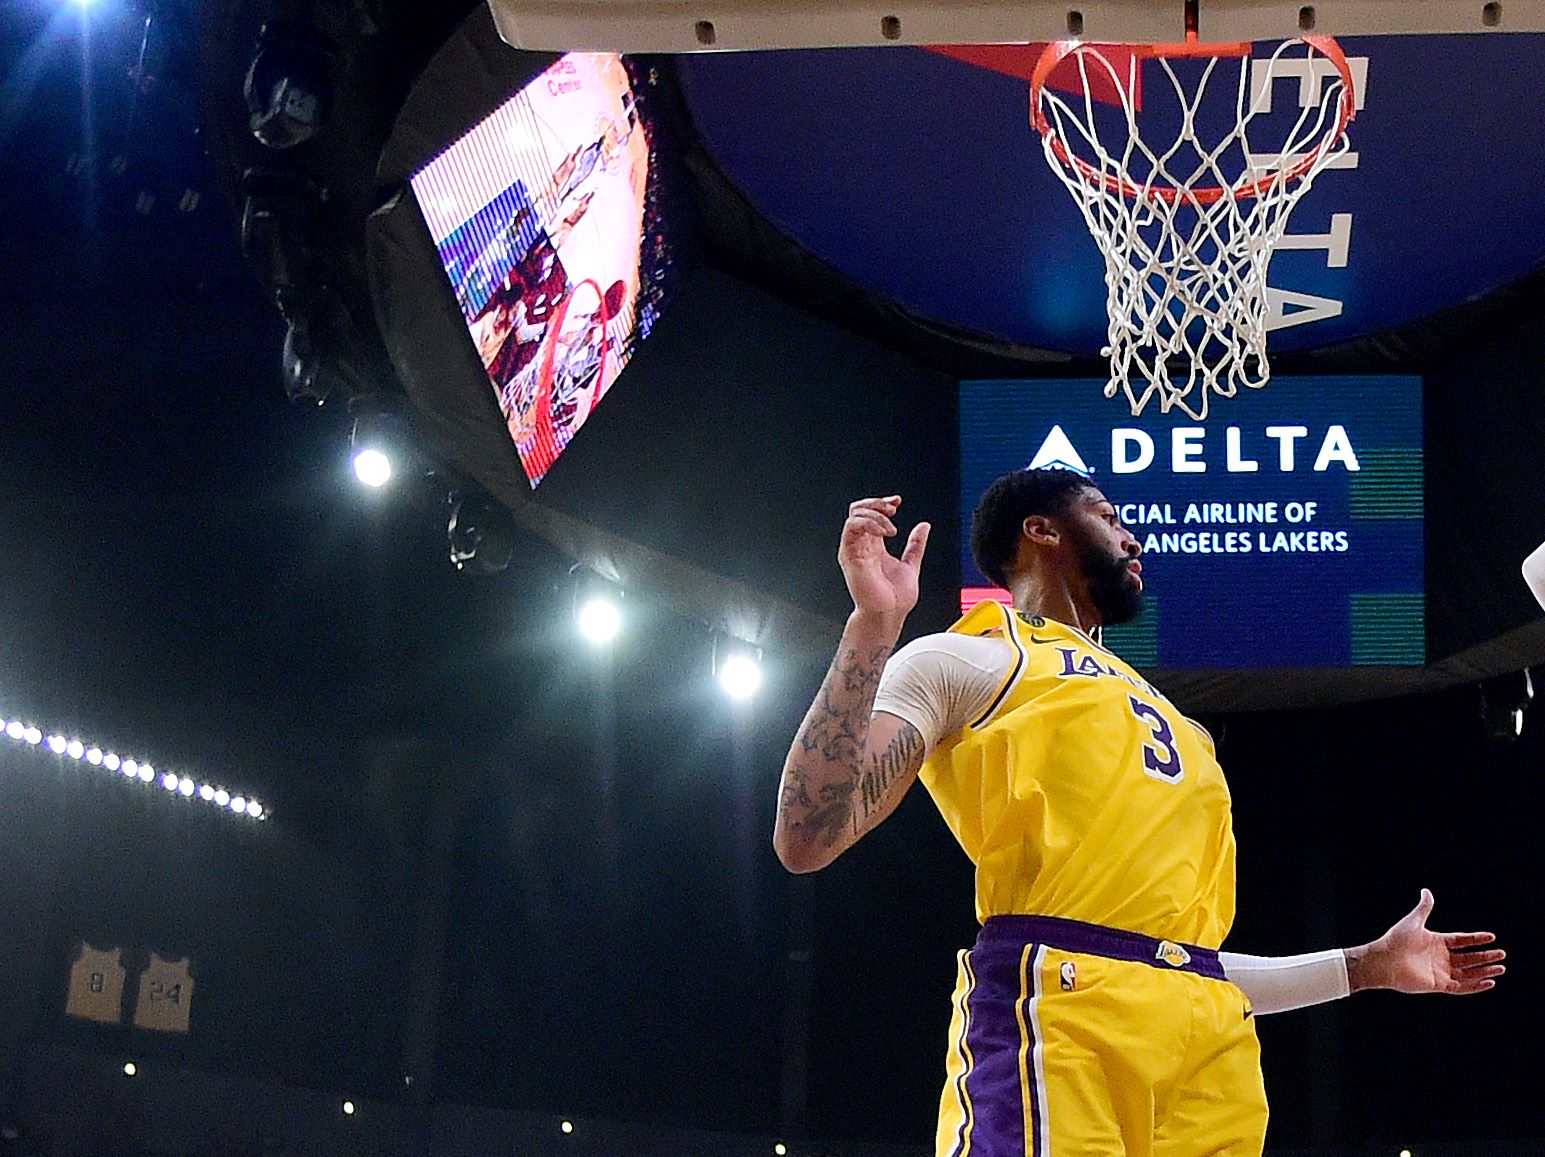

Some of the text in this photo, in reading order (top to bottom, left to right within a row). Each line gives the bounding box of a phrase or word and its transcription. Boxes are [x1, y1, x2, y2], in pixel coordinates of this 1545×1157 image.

[1111, 424, 1361, 474] DELTA
[1183, 502, 1278, 524] AIRLINE
[1284, 501, 1318, 523] OF
[1143, 530, 1349, 554] ANGELES LAKERS
[1127, 691, 1185, 785] 3
[91, 972, 104, 993] 8
[150, 981, 183, 1004] 24
